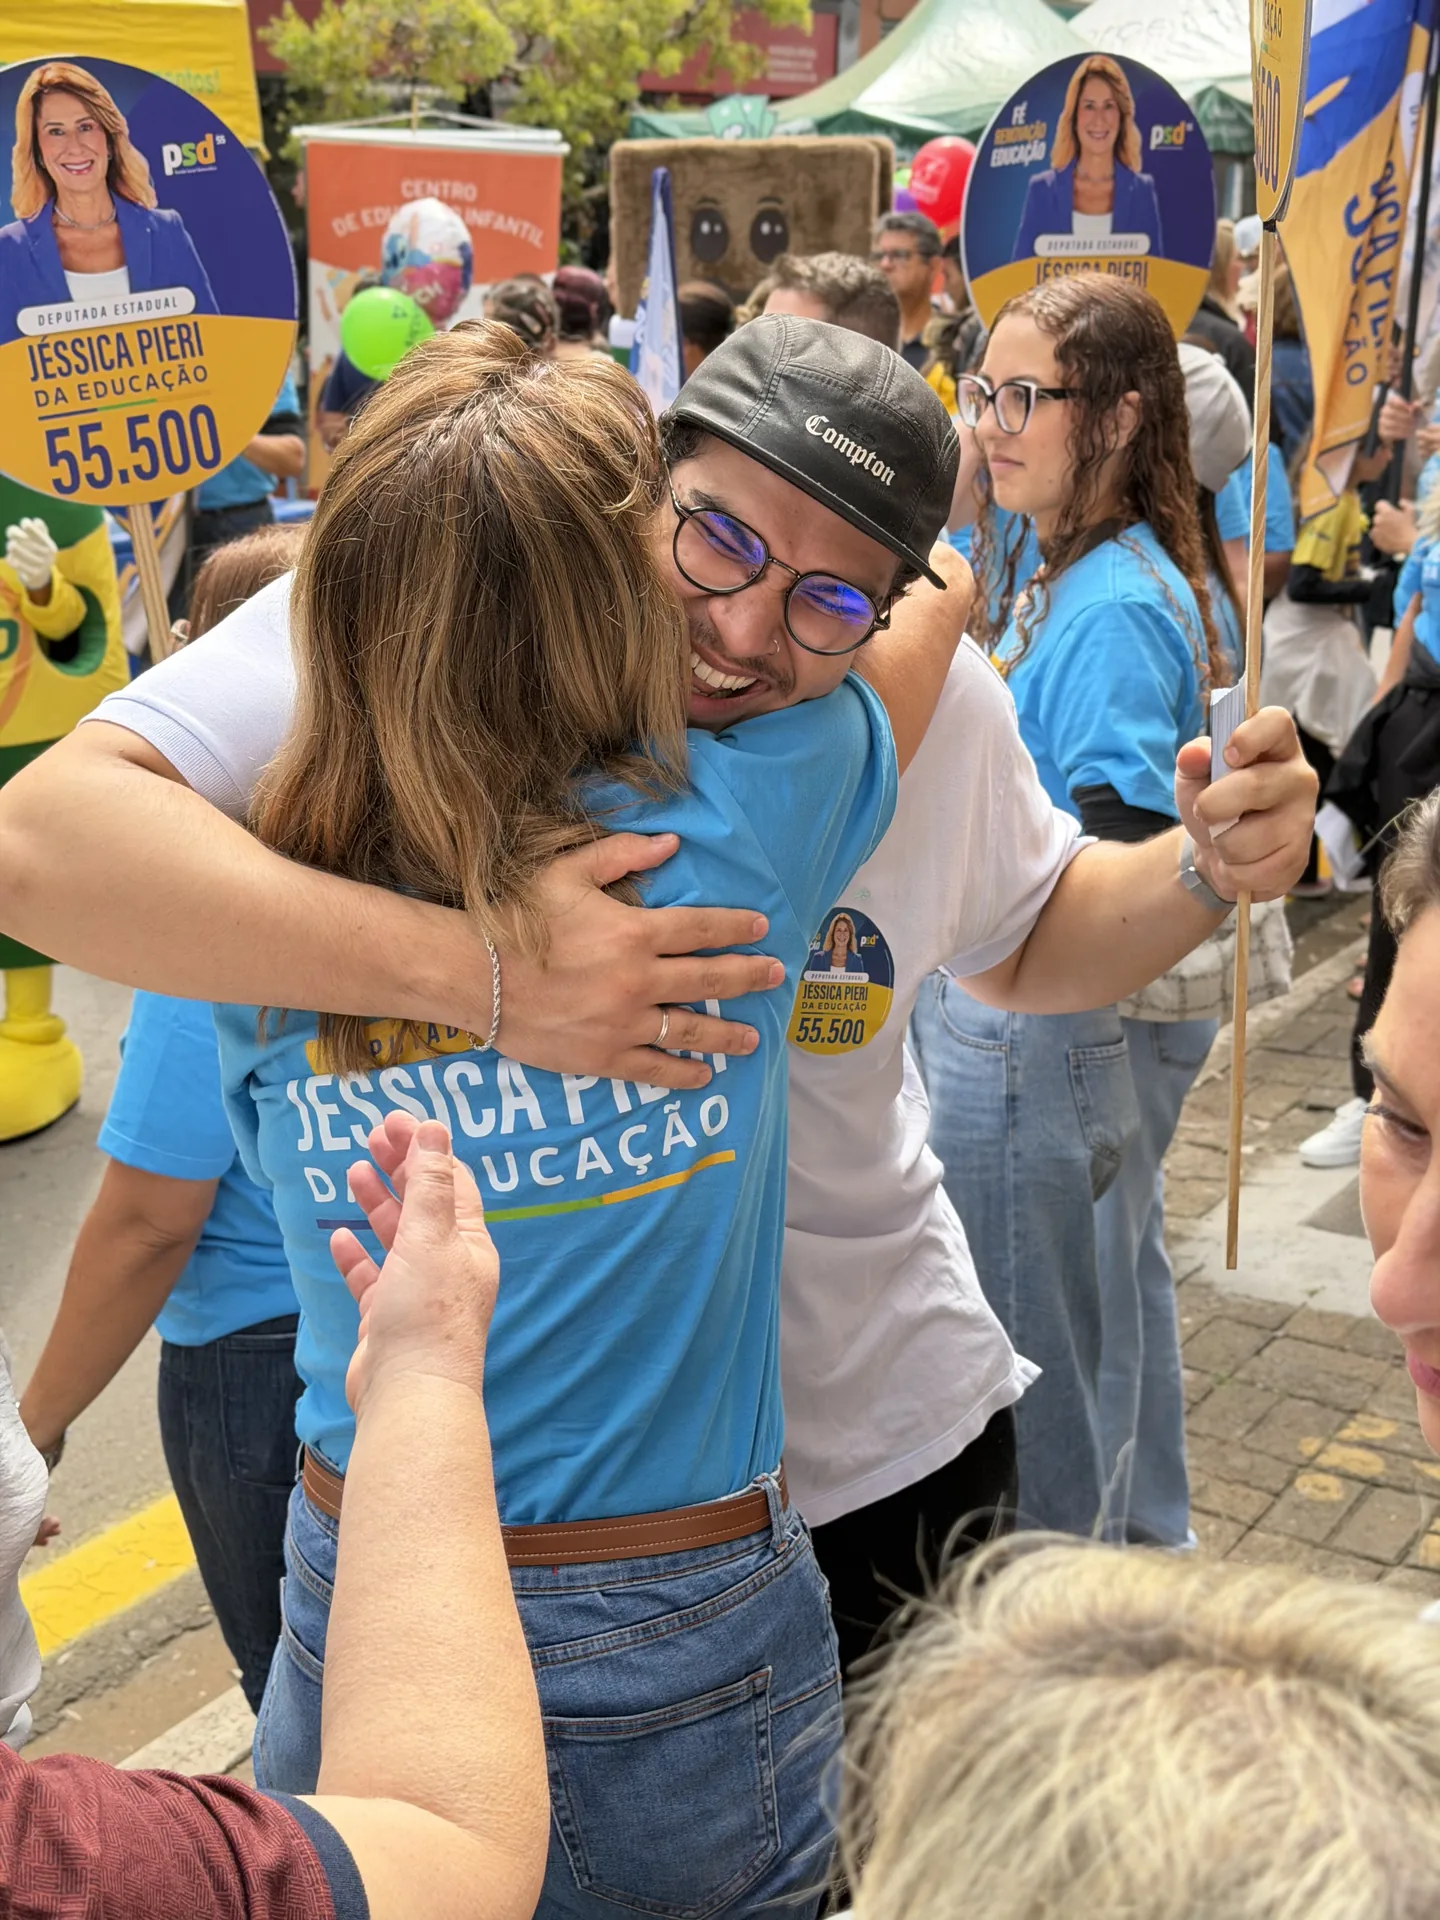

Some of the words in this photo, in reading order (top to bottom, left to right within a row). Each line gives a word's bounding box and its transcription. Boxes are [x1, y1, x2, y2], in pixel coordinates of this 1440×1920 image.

[1150, 121, 1186, 150] psd
[162, 133, 216, 176] psd
[990, 139, 1047, 168] EDUCAÇÃO
[400, 179, 478, 202] CENTRO
[331, 214, 361, 239] DE
[464, 207, 545, 249] INFANTIL
[38, 306, 108, 327] DEPUTADA
[114, 296, 178, 316] ESTADUAL
[27, 332, 134, 382] JÉSSICA
[136, 321, 204, 365] PIERI
[34, 387, 68, 408] DA
[77, 364, 208, 402] EDUCAÇÃO
[45, 404, 222, 495] 55.500
[805, 415, 896, 487] Compton
[801, 1001, 815, 1010] DA
[817, 1001, 867, 1012] EDUCAÇÃO
[802, 982, 842, 1001] JÉSSICA
[844, 985, 868, 1001] PIERI
[795, 1017, 865, 1045] 55.500
